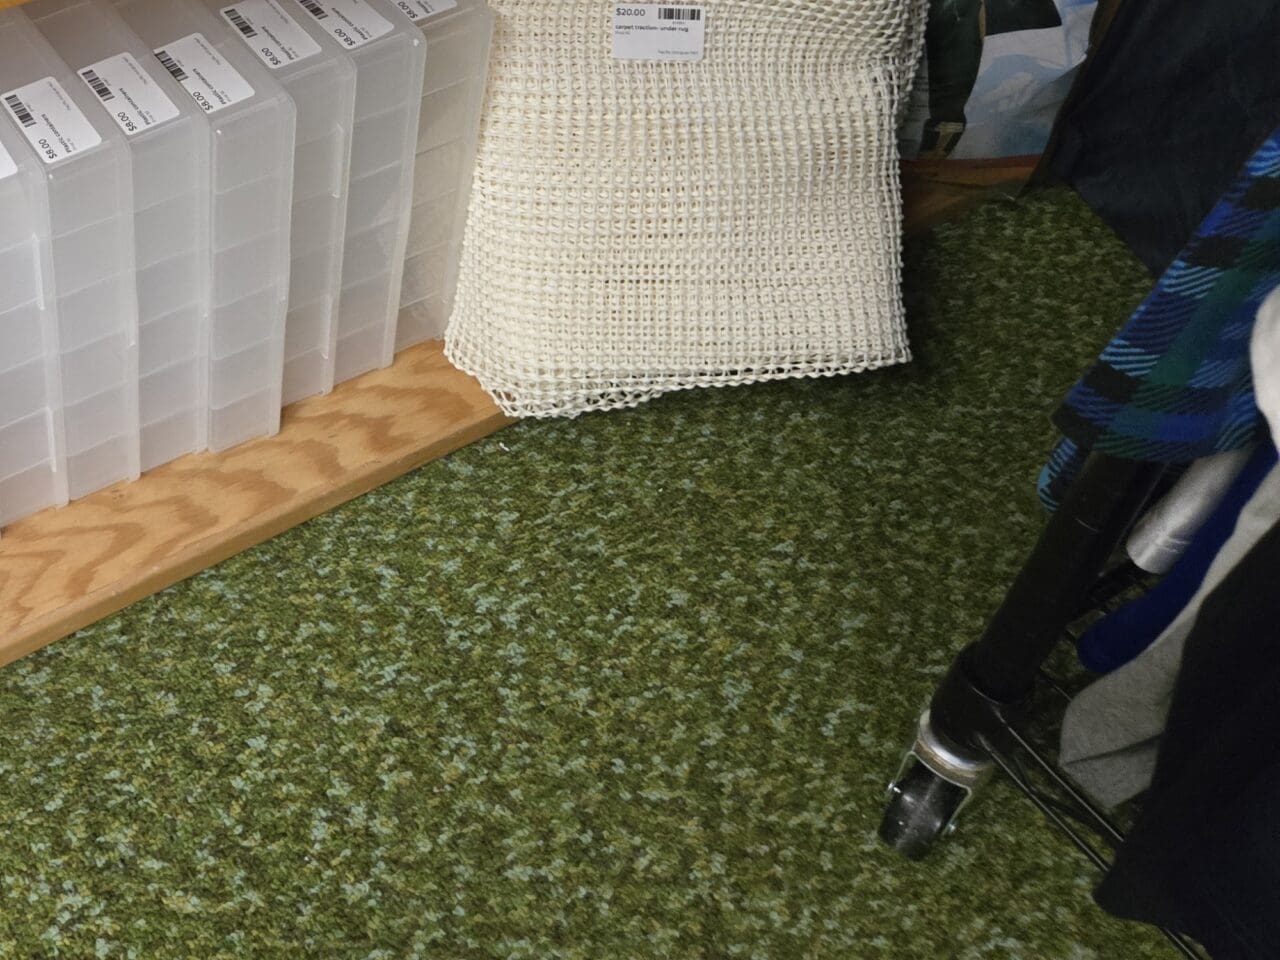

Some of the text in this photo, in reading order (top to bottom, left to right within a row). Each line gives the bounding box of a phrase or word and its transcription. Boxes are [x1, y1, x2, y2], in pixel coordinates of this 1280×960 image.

[395, 0, 419, 19] $8.00
[615, 8, 646, 17] $20.00
[332, 27, 356, 46] $8.00
[259, 46, 282, 66] $8.00
[116, 87, 139, 111] containers
[190, 90, 214, 111] $8.00
[39, 113, 61, 138] containers
[115, 110, 138, 132] $8.00
[134, 109, 152, 126] Plastic
[36, 137, 58, 160] $8.00
[56, 136, 72, 154] Plastic
